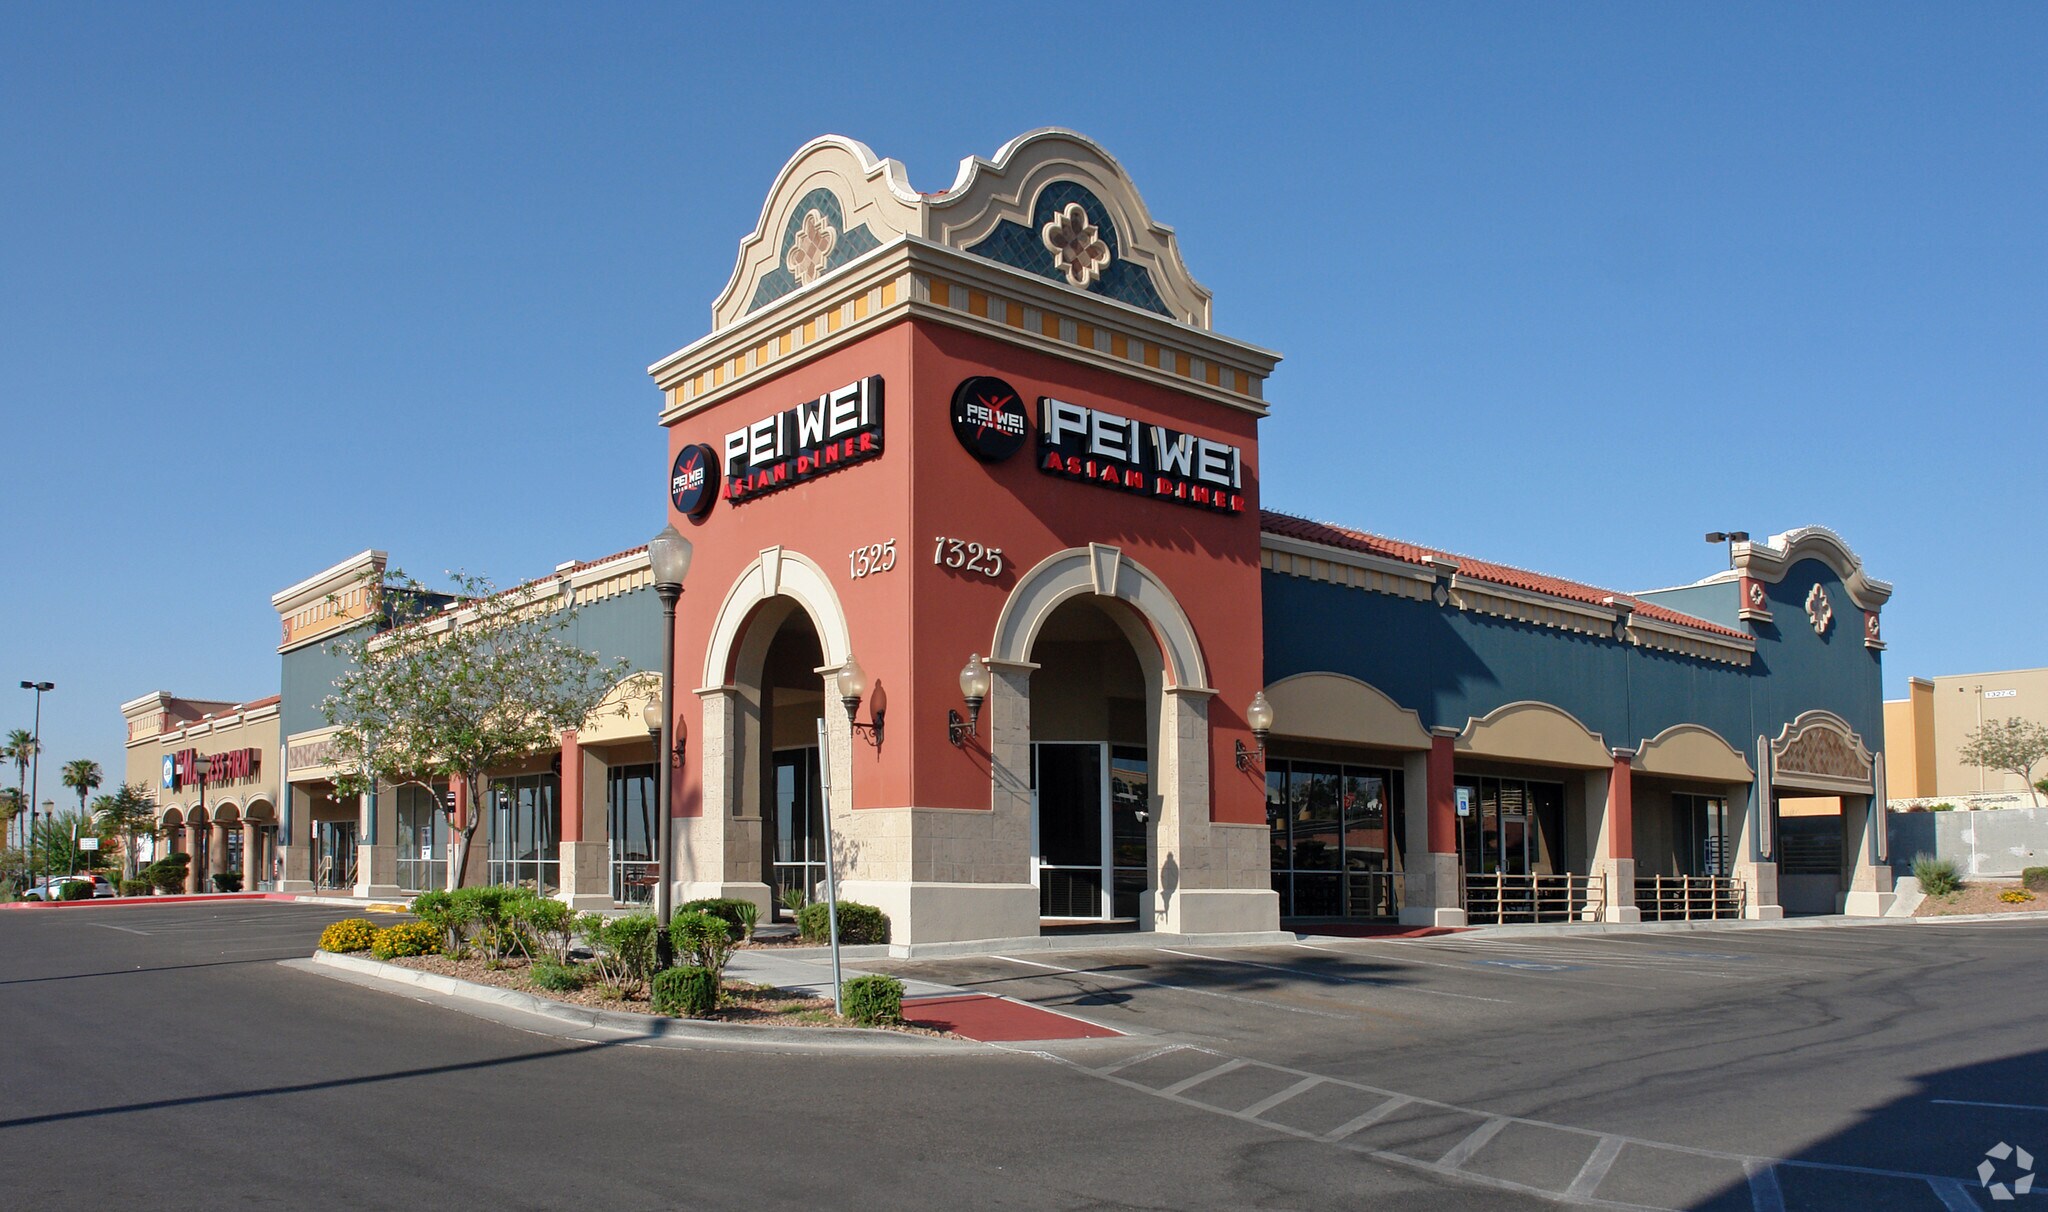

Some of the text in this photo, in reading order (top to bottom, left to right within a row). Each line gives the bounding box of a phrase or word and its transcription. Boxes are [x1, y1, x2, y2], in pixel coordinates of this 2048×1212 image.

[724, 376, 869, 477] PEI WEI
[966, 417, 1024, 435] ASIAN DINER
[967, 403, 1024, 429] PEI WEI
[1050, 398, 1242, 489] PEI WEI
[672, 467, 704, 489] PEI WEI
[722, 432, 872, 500] ASIAN DINER
[1047, 451, 1246, 512] ASIAN DINER
[848, 537, 897, 580] 1325
[934, 536, 1003, 577] 1325
[1986, 690, 2015, 698] 1327-C
[225, 748, 250, 780] FIRM
